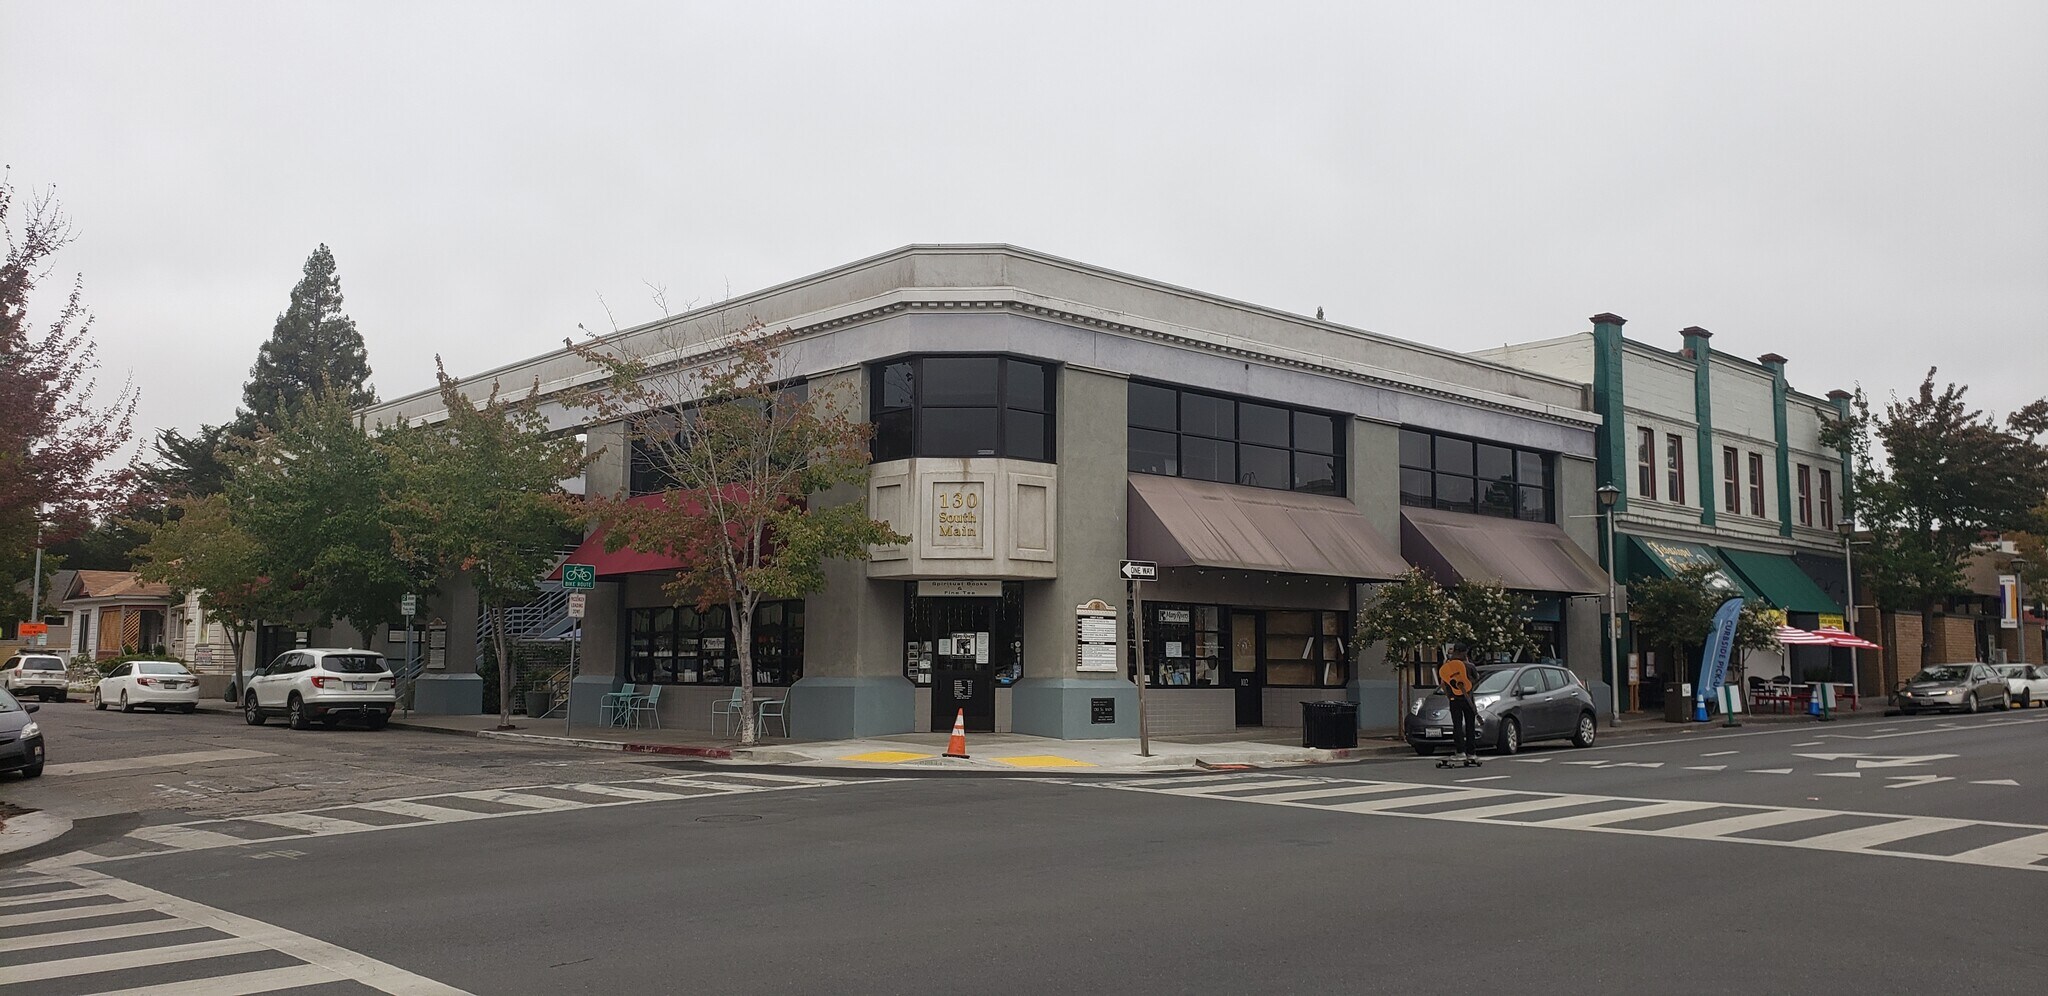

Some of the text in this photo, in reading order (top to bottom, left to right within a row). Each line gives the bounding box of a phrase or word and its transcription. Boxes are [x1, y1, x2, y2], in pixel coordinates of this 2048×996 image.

[940, 492, 978, 509] 130
[939, 512, 977, 524] South
[939, 525, 976, 537] Main
[1130, 566, 1153, 575] ONE WAY
[1711, 619, 1733, 692] CURBSIDE PICK-U
